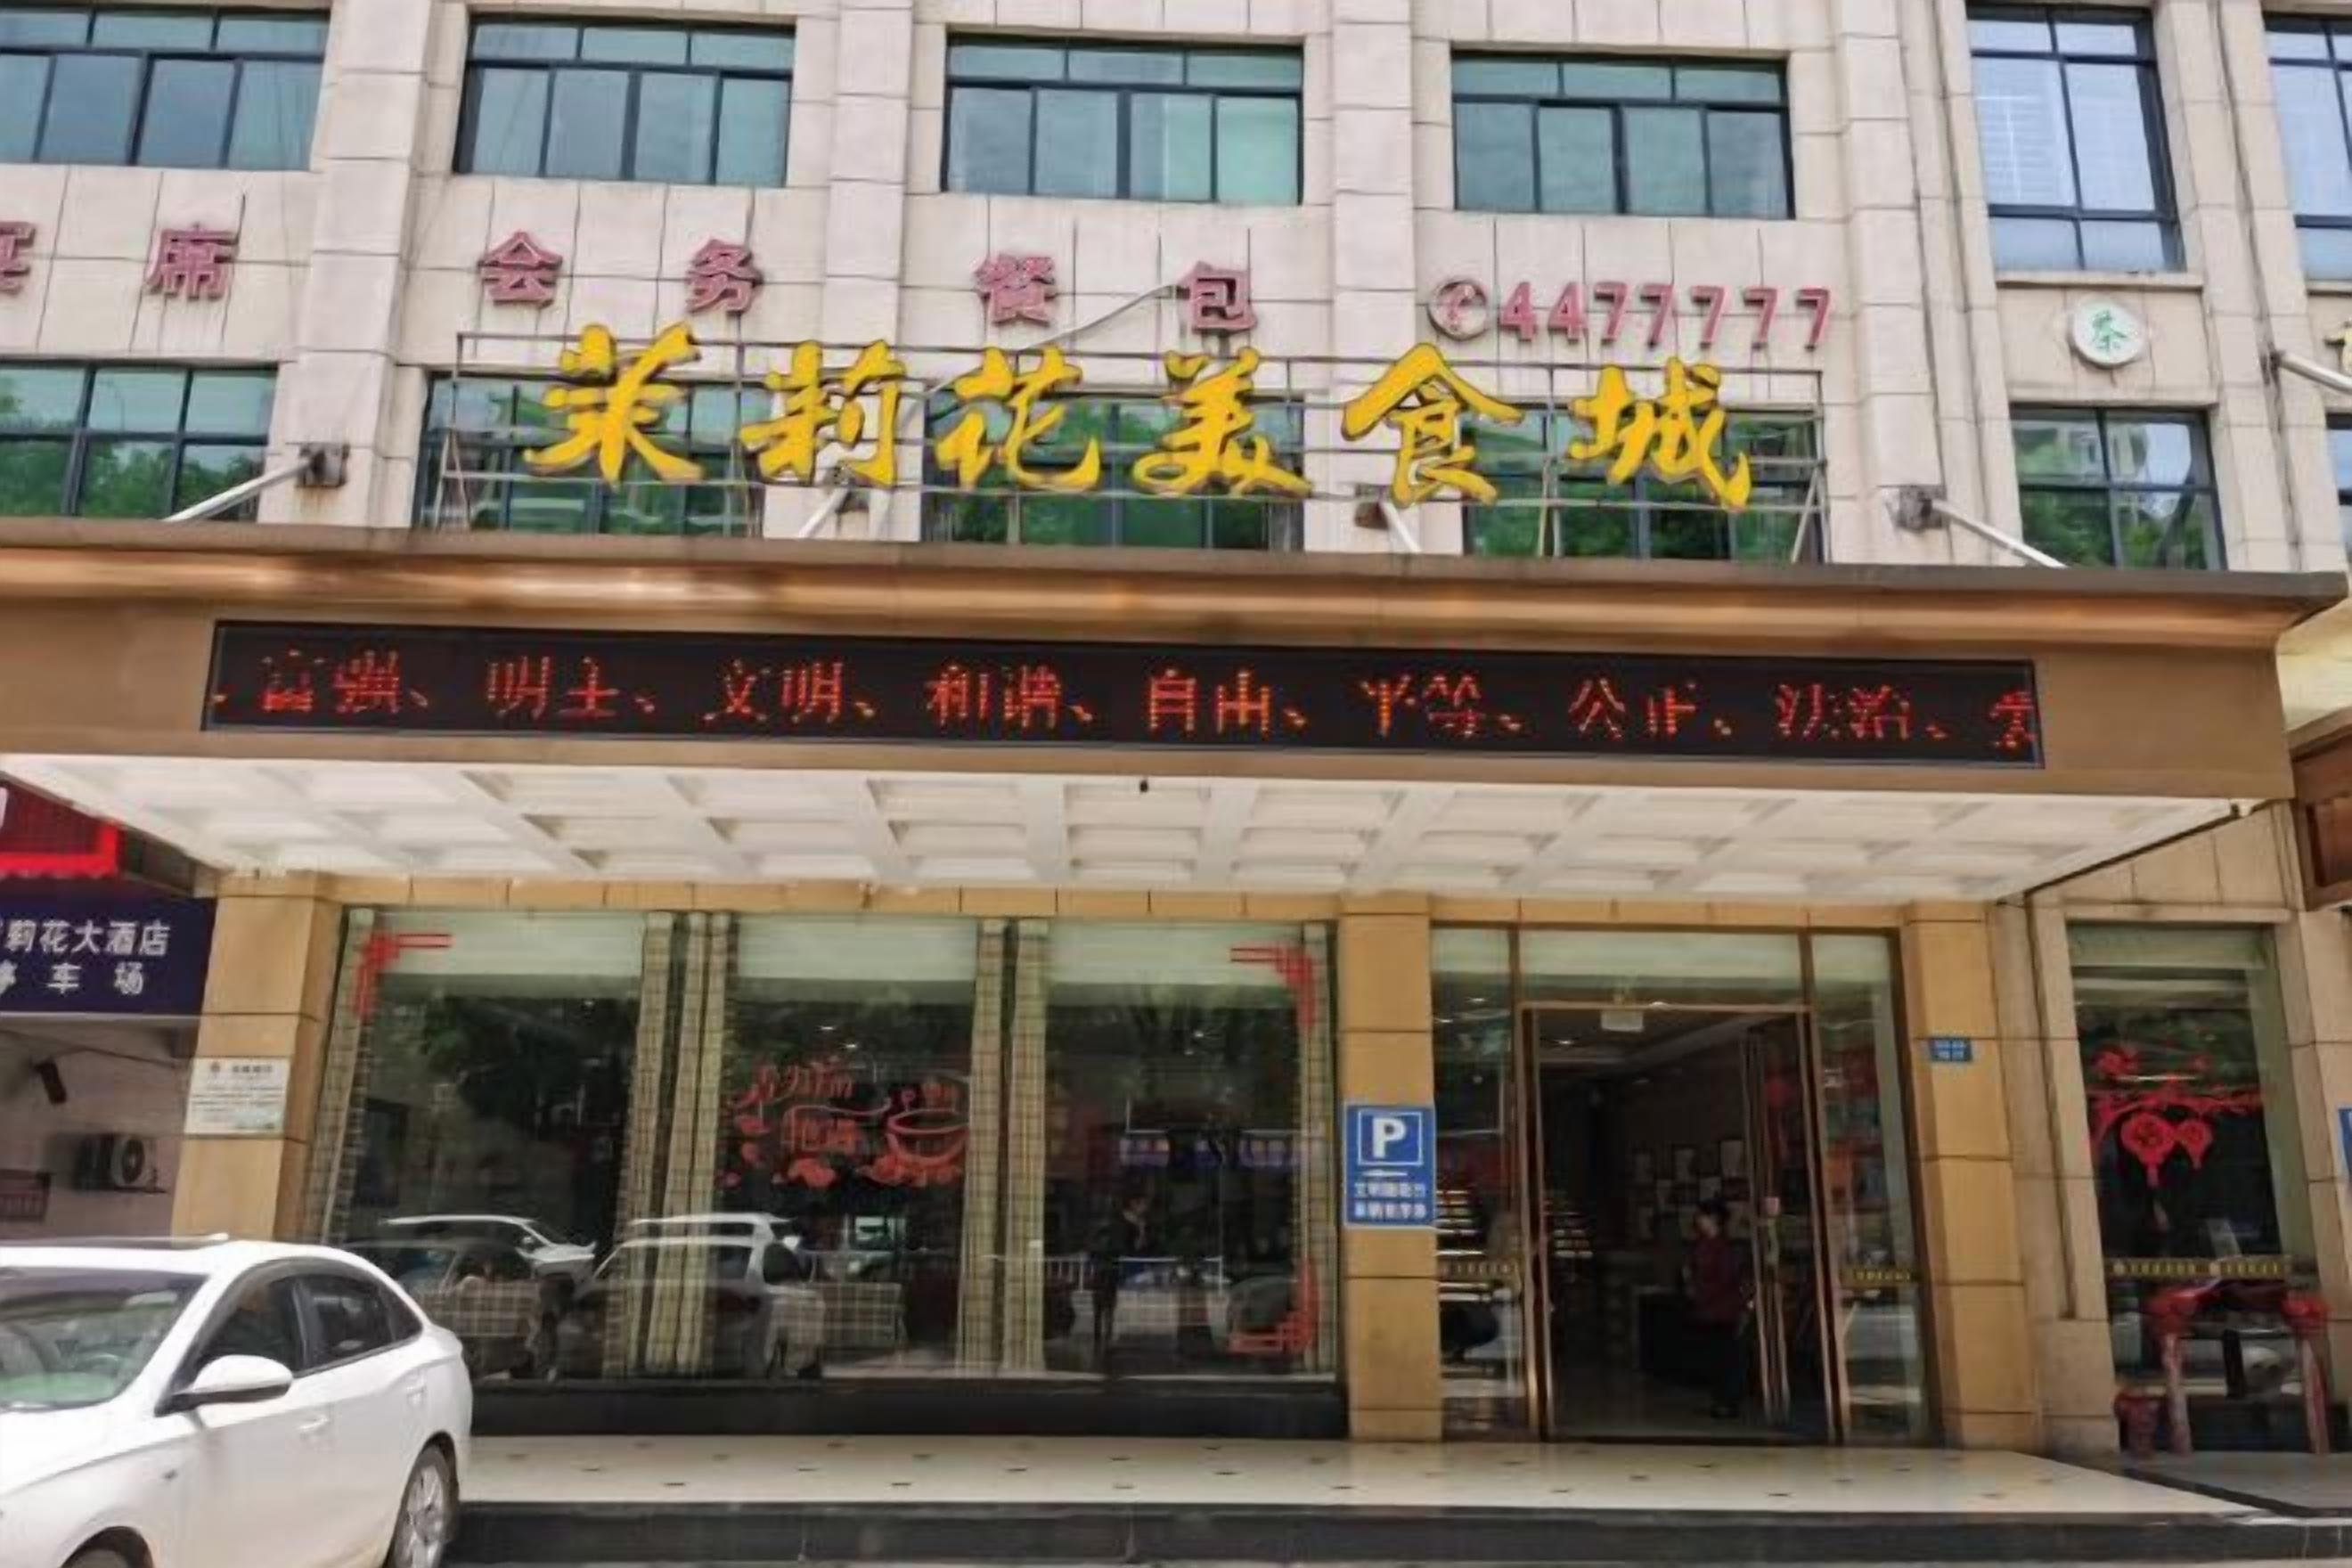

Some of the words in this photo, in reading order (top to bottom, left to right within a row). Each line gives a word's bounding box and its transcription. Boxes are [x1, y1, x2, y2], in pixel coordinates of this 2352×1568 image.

[1498, 281, 1832, 353] 4477777
[521, 321, 1753, 514] 茉莉花美食城
[0, 919, 171, 957] 莉花大酒店
[1373, 1117, 1406, 1158] P
